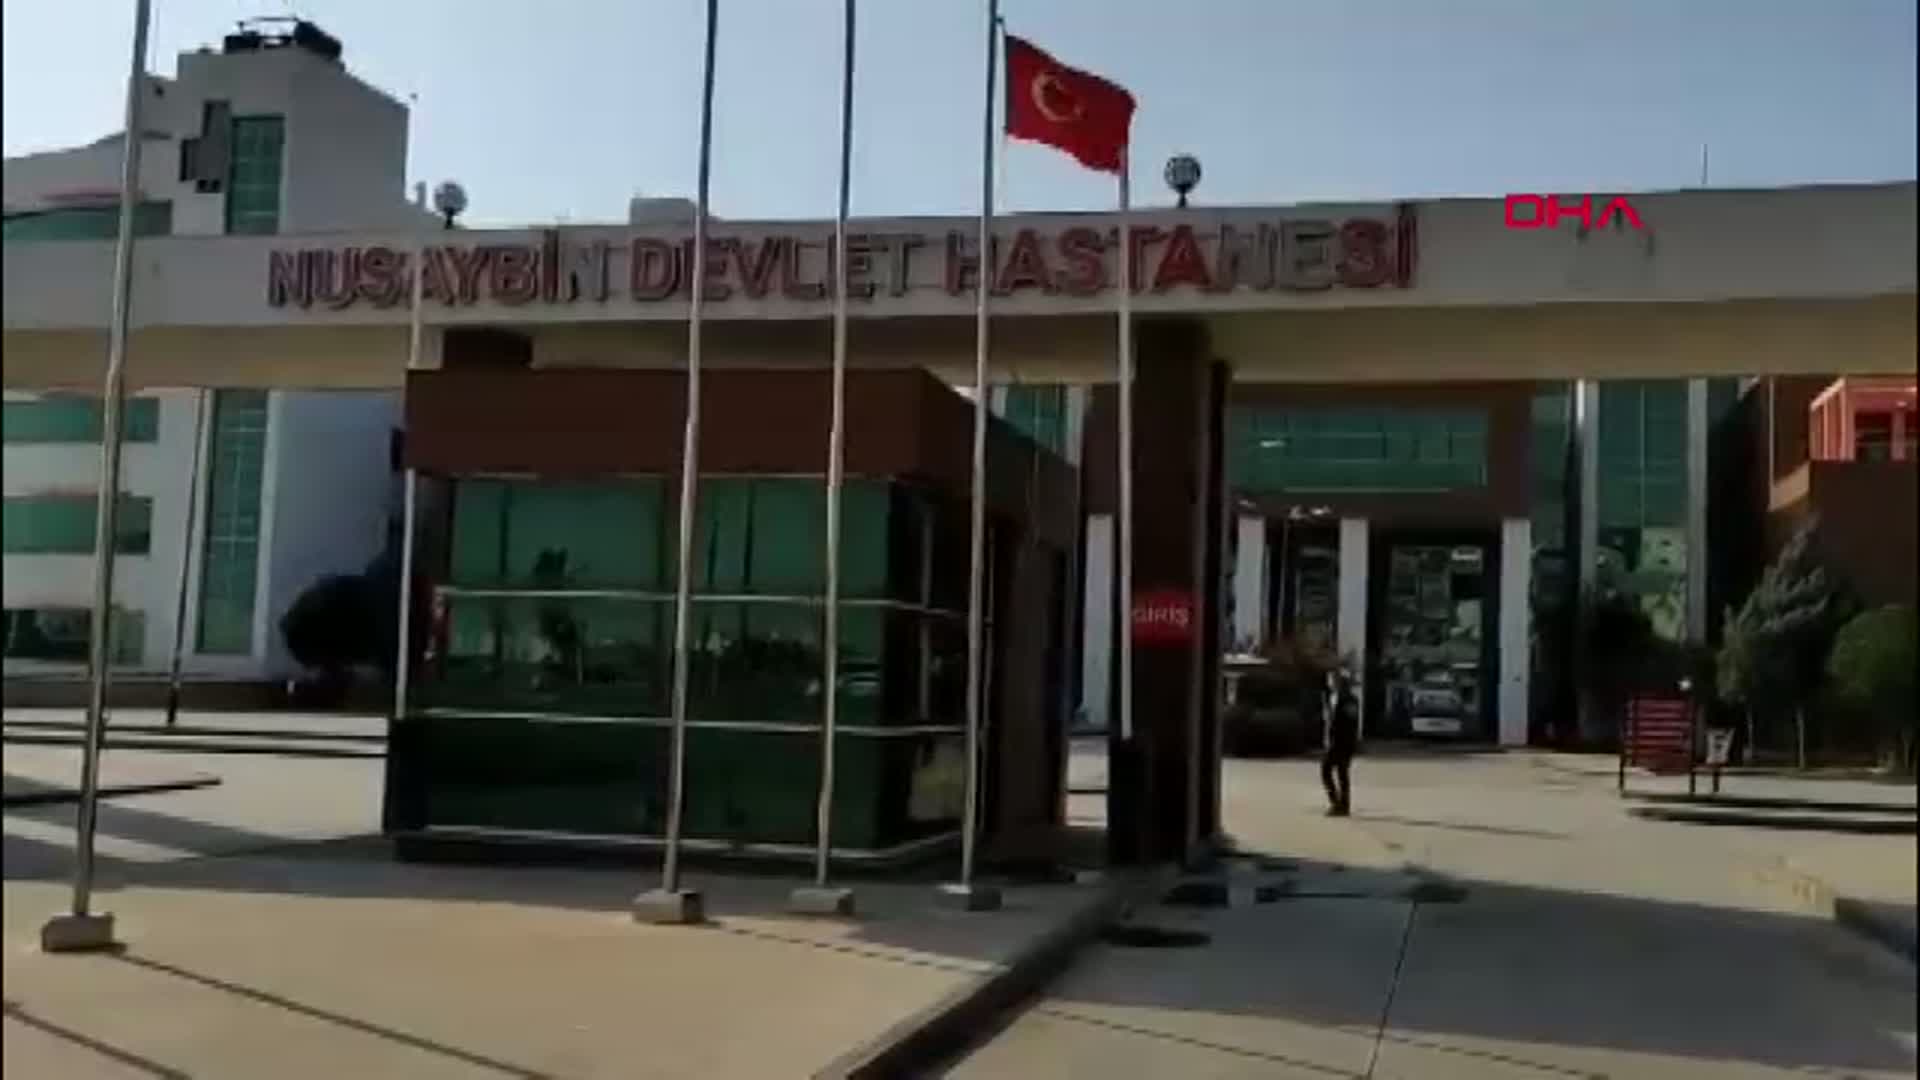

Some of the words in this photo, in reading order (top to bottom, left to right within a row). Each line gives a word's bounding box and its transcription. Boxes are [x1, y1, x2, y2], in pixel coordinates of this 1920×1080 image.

[268, 229, 609, 309] NUSAYBİN
[631, 234, 925, 301] DEVLET
[944, 202, 1418, 297] HASTANESİ
